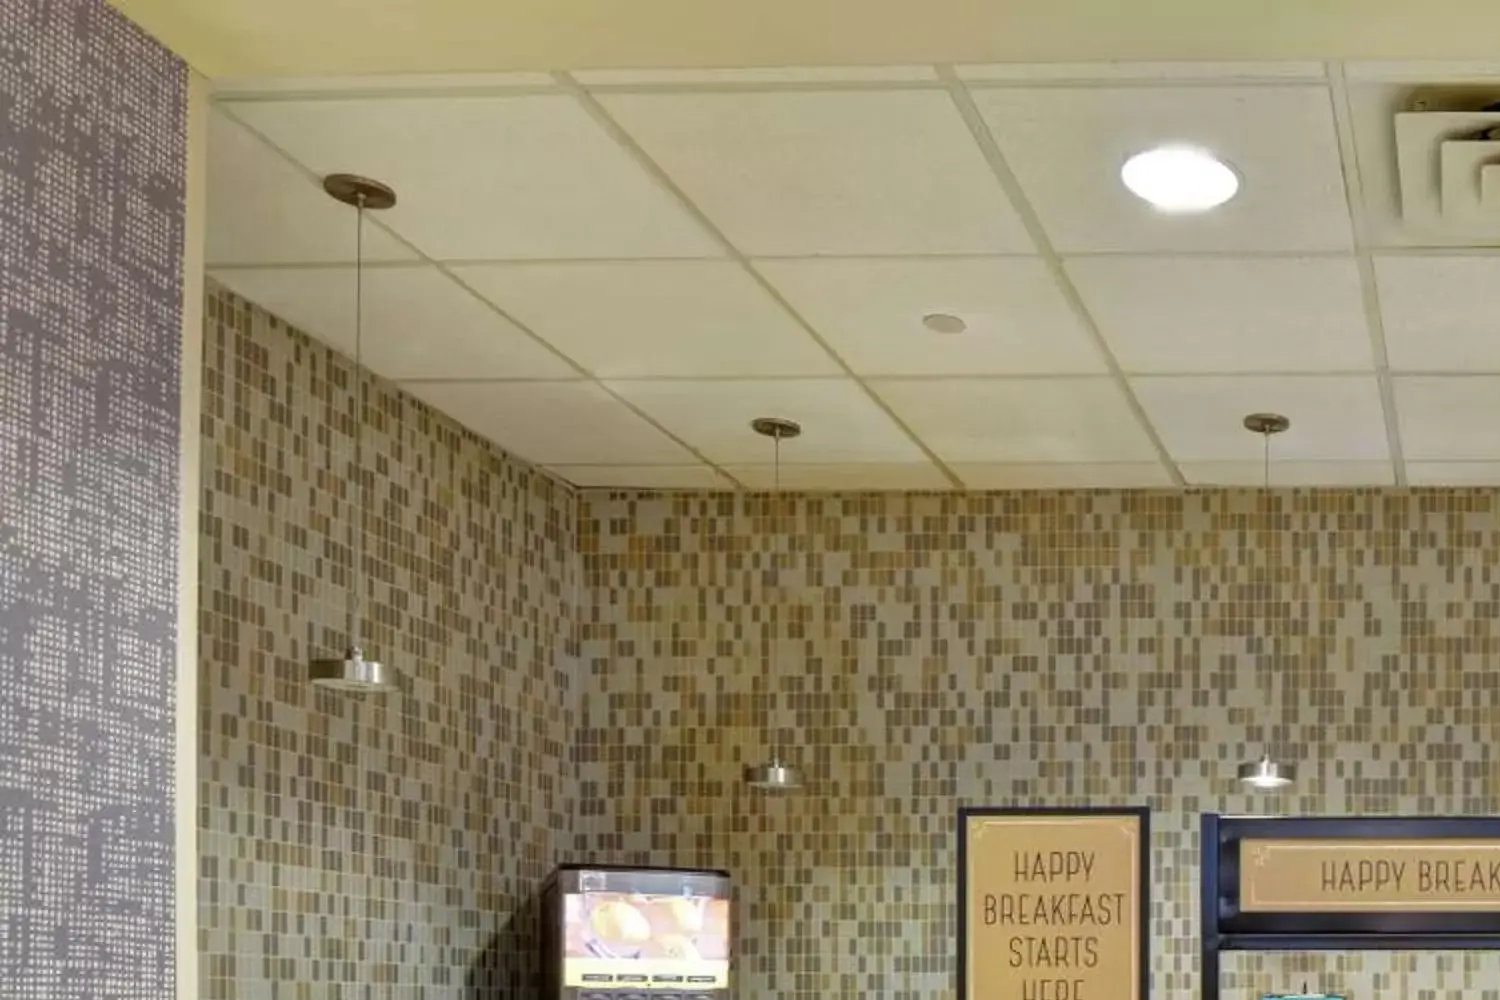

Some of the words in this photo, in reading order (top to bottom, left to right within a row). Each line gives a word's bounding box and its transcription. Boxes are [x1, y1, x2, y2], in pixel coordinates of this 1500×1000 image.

[1014, 851, 1096, 882] HAPPY
[1321, 859, 1406, 892] HAPPY
[984, 892, 1126, 925] BREAKFAST
[1008, 936, 1099, 968] STARTS
